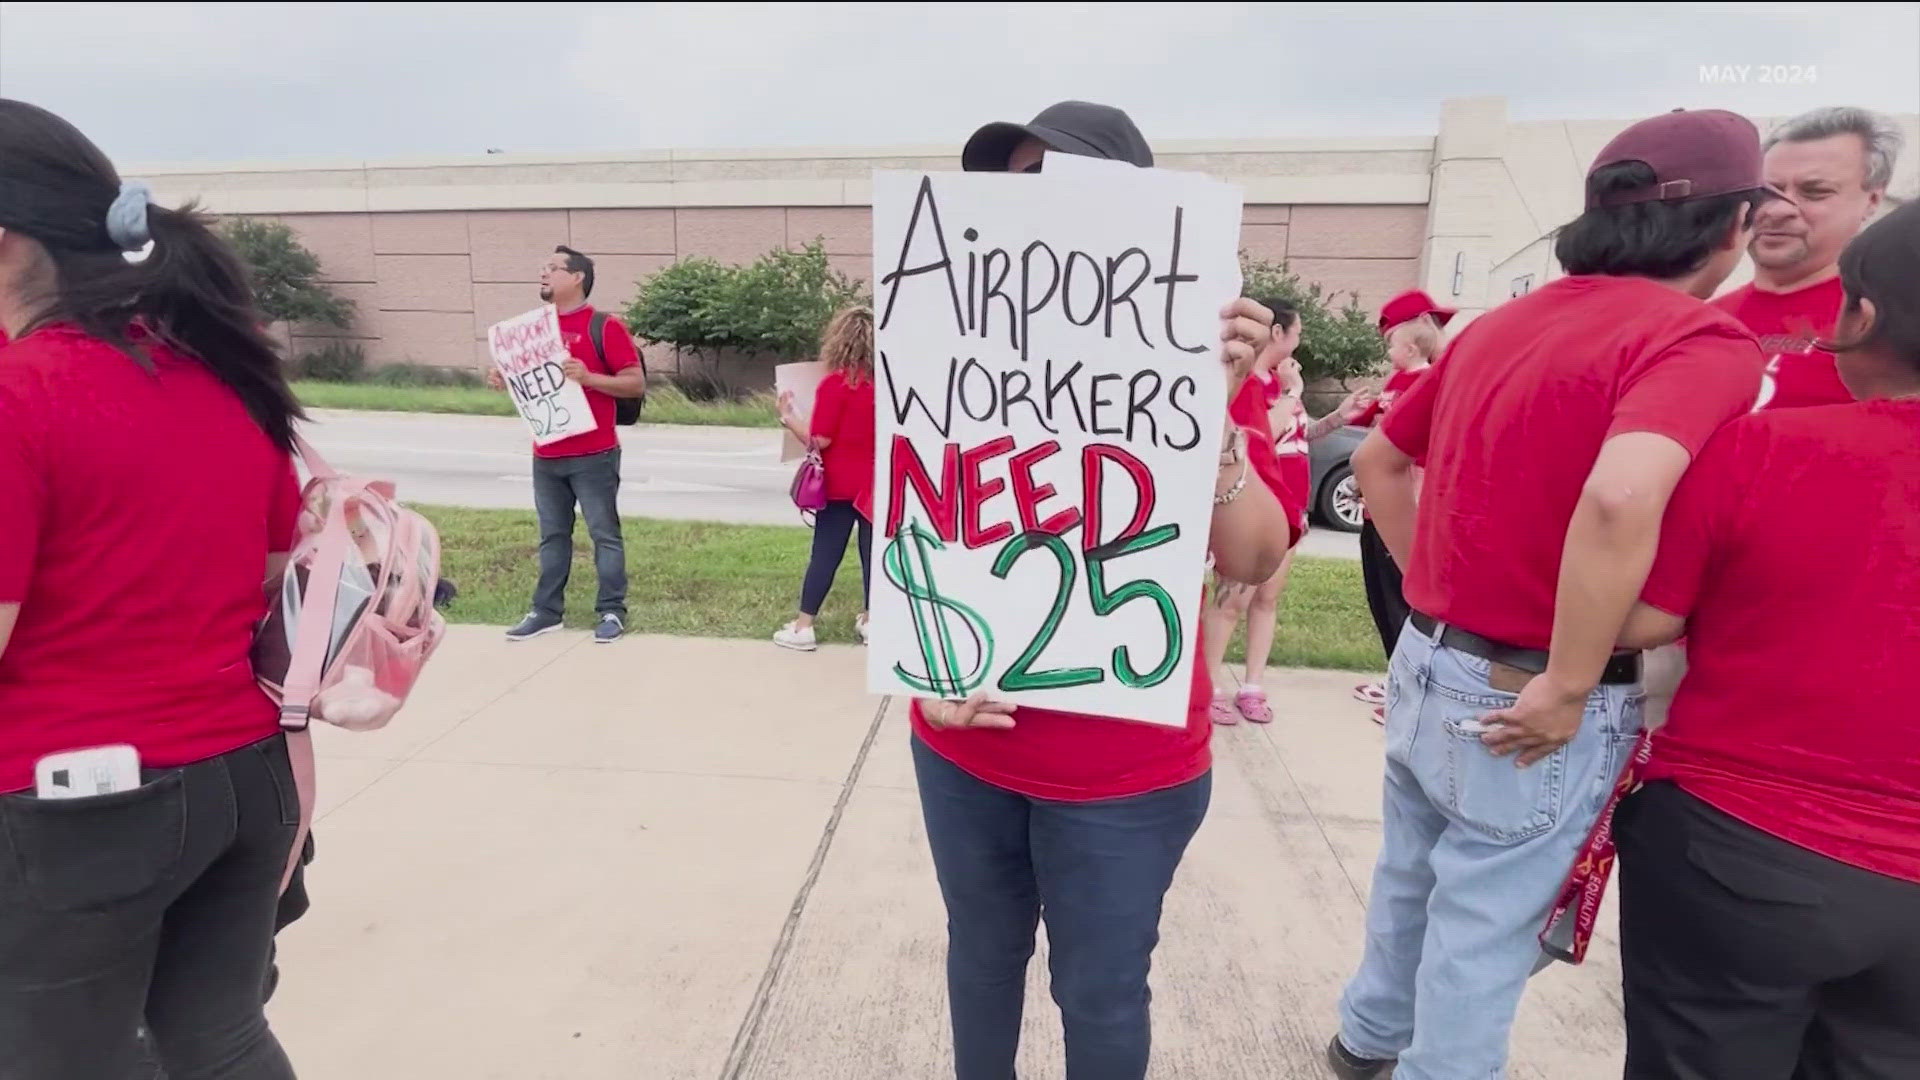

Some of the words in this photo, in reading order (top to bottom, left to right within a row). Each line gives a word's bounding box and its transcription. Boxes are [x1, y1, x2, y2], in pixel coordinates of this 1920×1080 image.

[508, 361, 565, 404] NEED
[519, 391, 571, 436] $25
[880, 350, 1201, 451] WORKERS
[885, 434, 1157, 553] NEED
[883, 516, 1183, 699] $25
[1580, 871, 1602, 931] EQUALITY
